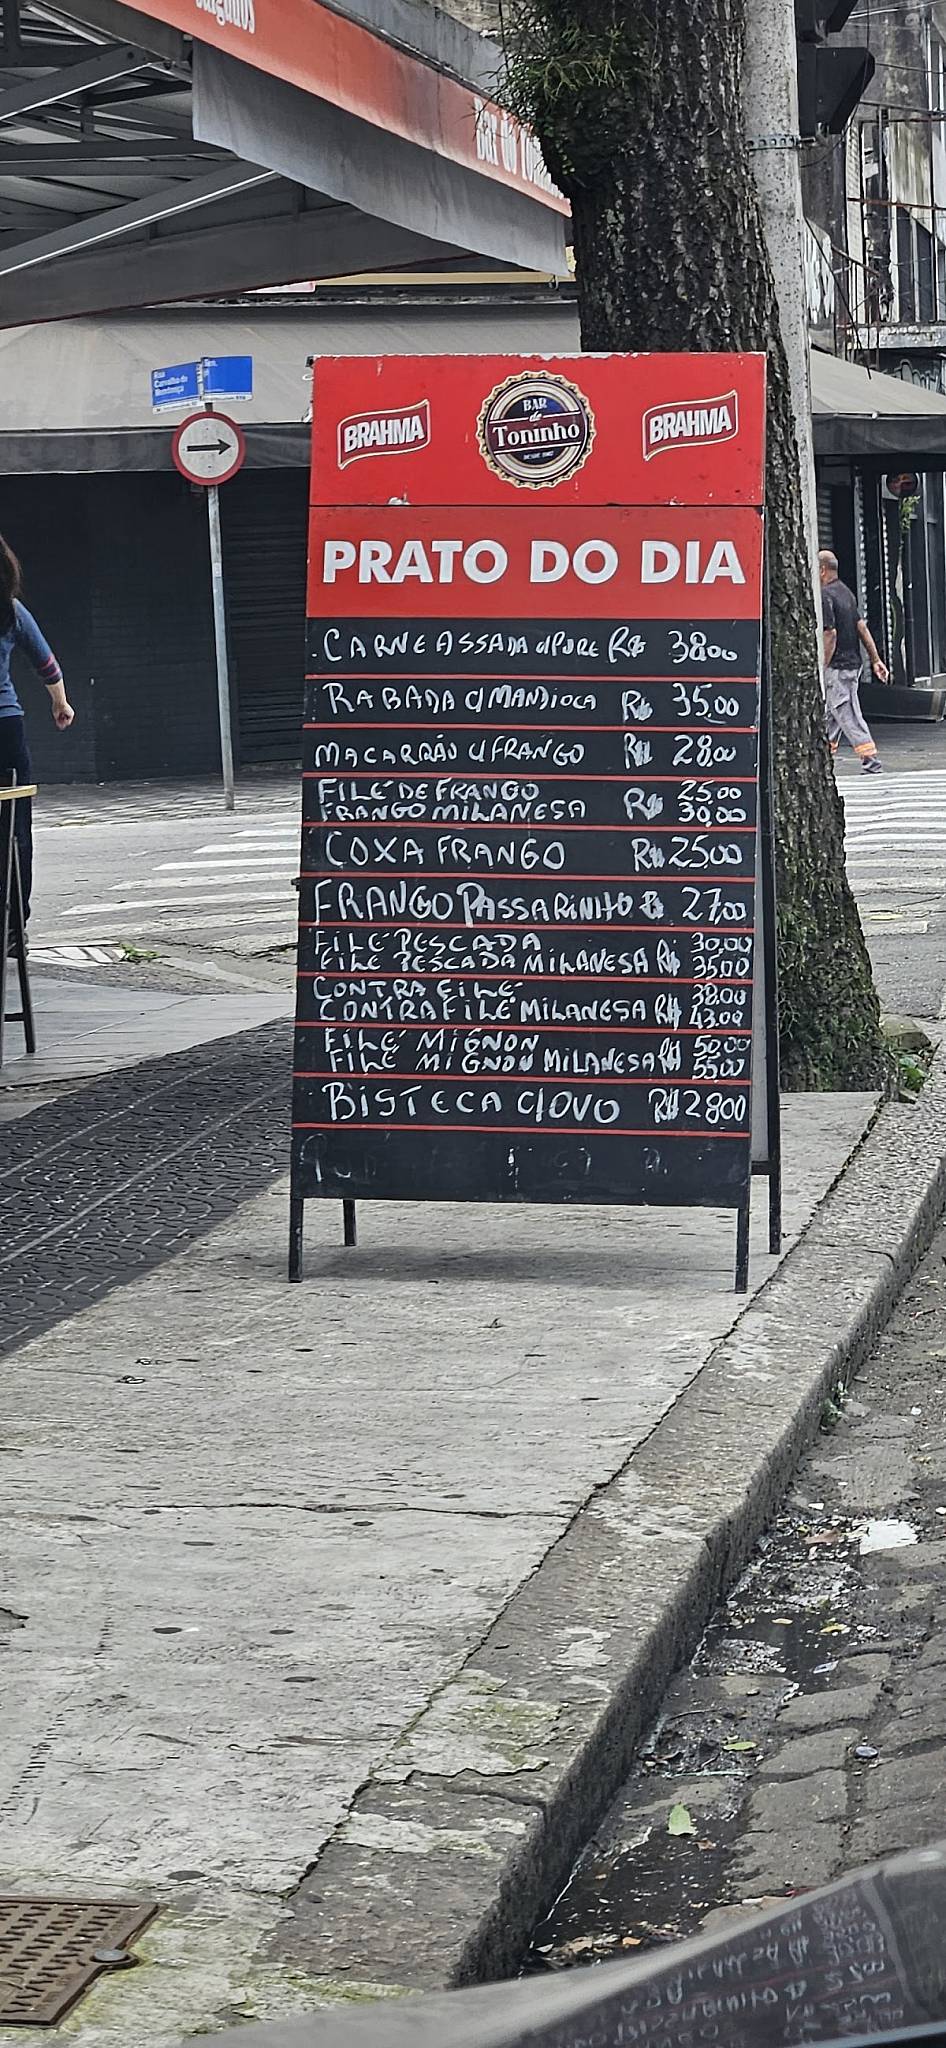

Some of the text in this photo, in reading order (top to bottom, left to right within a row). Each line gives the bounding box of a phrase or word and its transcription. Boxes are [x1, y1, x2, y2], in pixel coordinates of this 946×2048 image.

[523, 398, 548, 411] BAR
[529, 411, 543, 422] de
[344, 413, 425, 453] BRAHMA
[492, 422, 580, 447] Toninho
[649, 404, 733, 445] BRAHMA
[322, 539, 746, 585] PRATO DO DIA
[323, 628, 426, 661] CARNE
[436, 630, 528, 656] ASSADA
[322, 682, 455, 714] RABADA
[318, 777, 394, 802] FILÉ
[398, 782, 429, 800] DE
[435, 777, 540, 802] FRANGO
[320, 801, 426, 822] FRANGO
[325, 831, 424, 867] COXA
[437, 835, 565, 870] FRANGO
[315, 879, 454, 926] FRANGO
[393, 928, 542, 955] PESCADA
[393, 950, 516, 972] PESCADA
[523, 948, 649, 974] MILANESA
[313, 976, 426, 1000] CONTRA
[520, 997, 646, 1023] MILANESA
[416, 1028, 540, 1052] MIGNON
[415, 1052, 534, 1074] MIGNON
[543, 1047, 655, 1075] MILANESA
[321, 1082, 502, 1120] BISTECA
